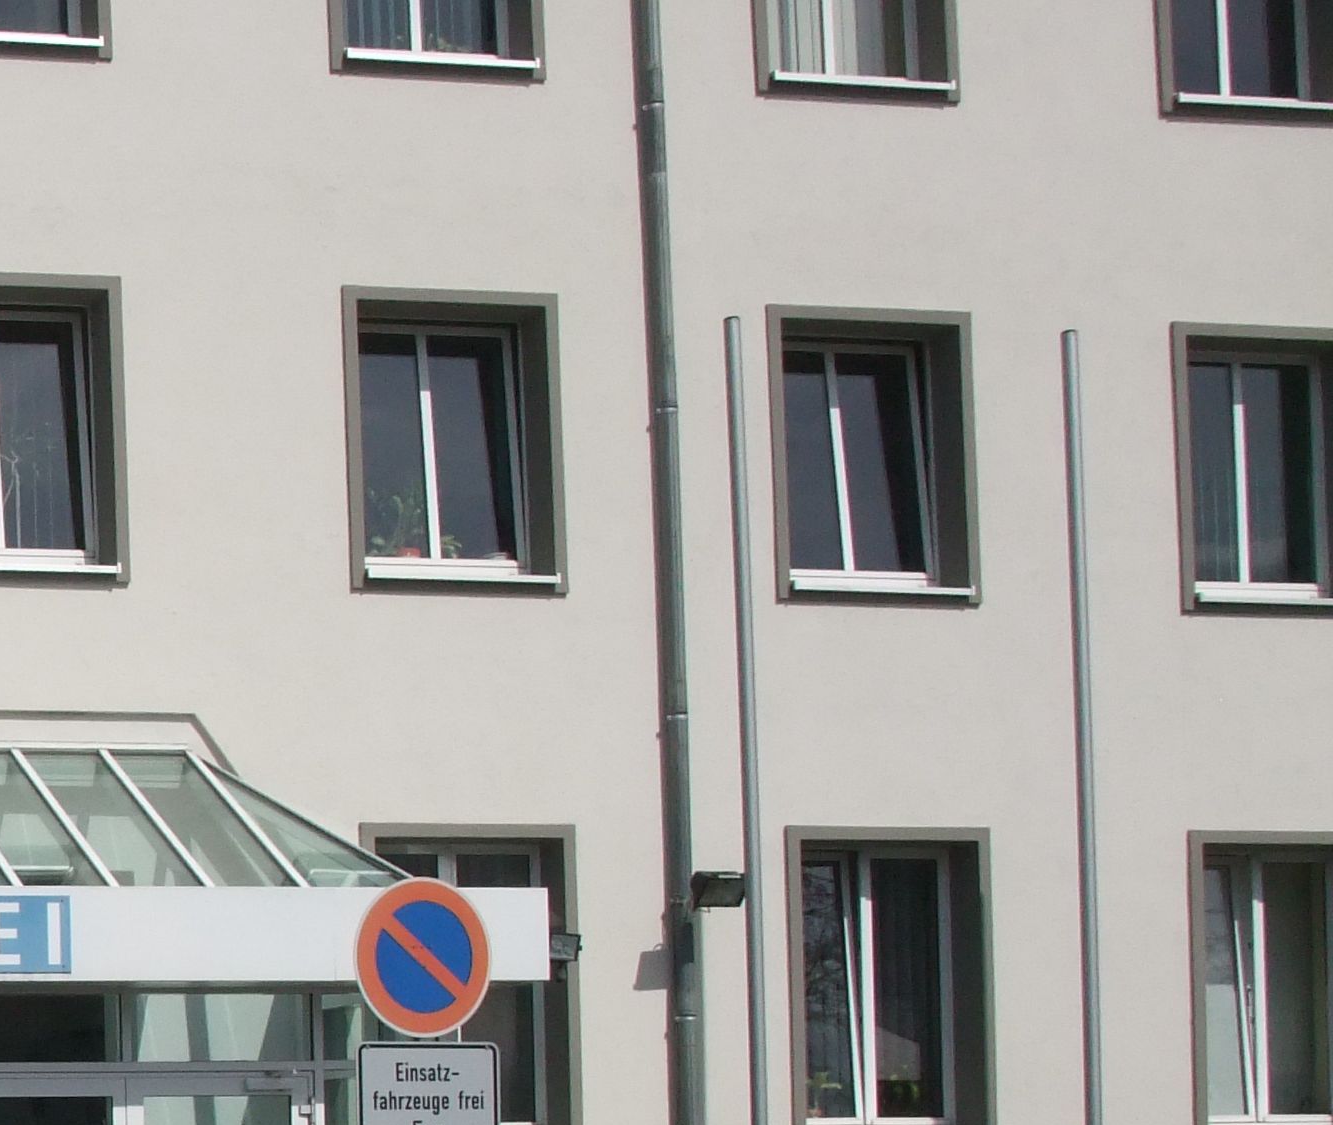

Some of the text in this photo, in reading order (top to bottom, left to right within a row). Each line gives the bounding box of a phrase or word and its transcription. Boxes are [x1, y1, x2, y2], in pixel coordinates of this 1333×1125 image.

[395, 1062, 460, 1082] Einsatz-
[373, 1090, 485, 1115] fahrzeuge frei
